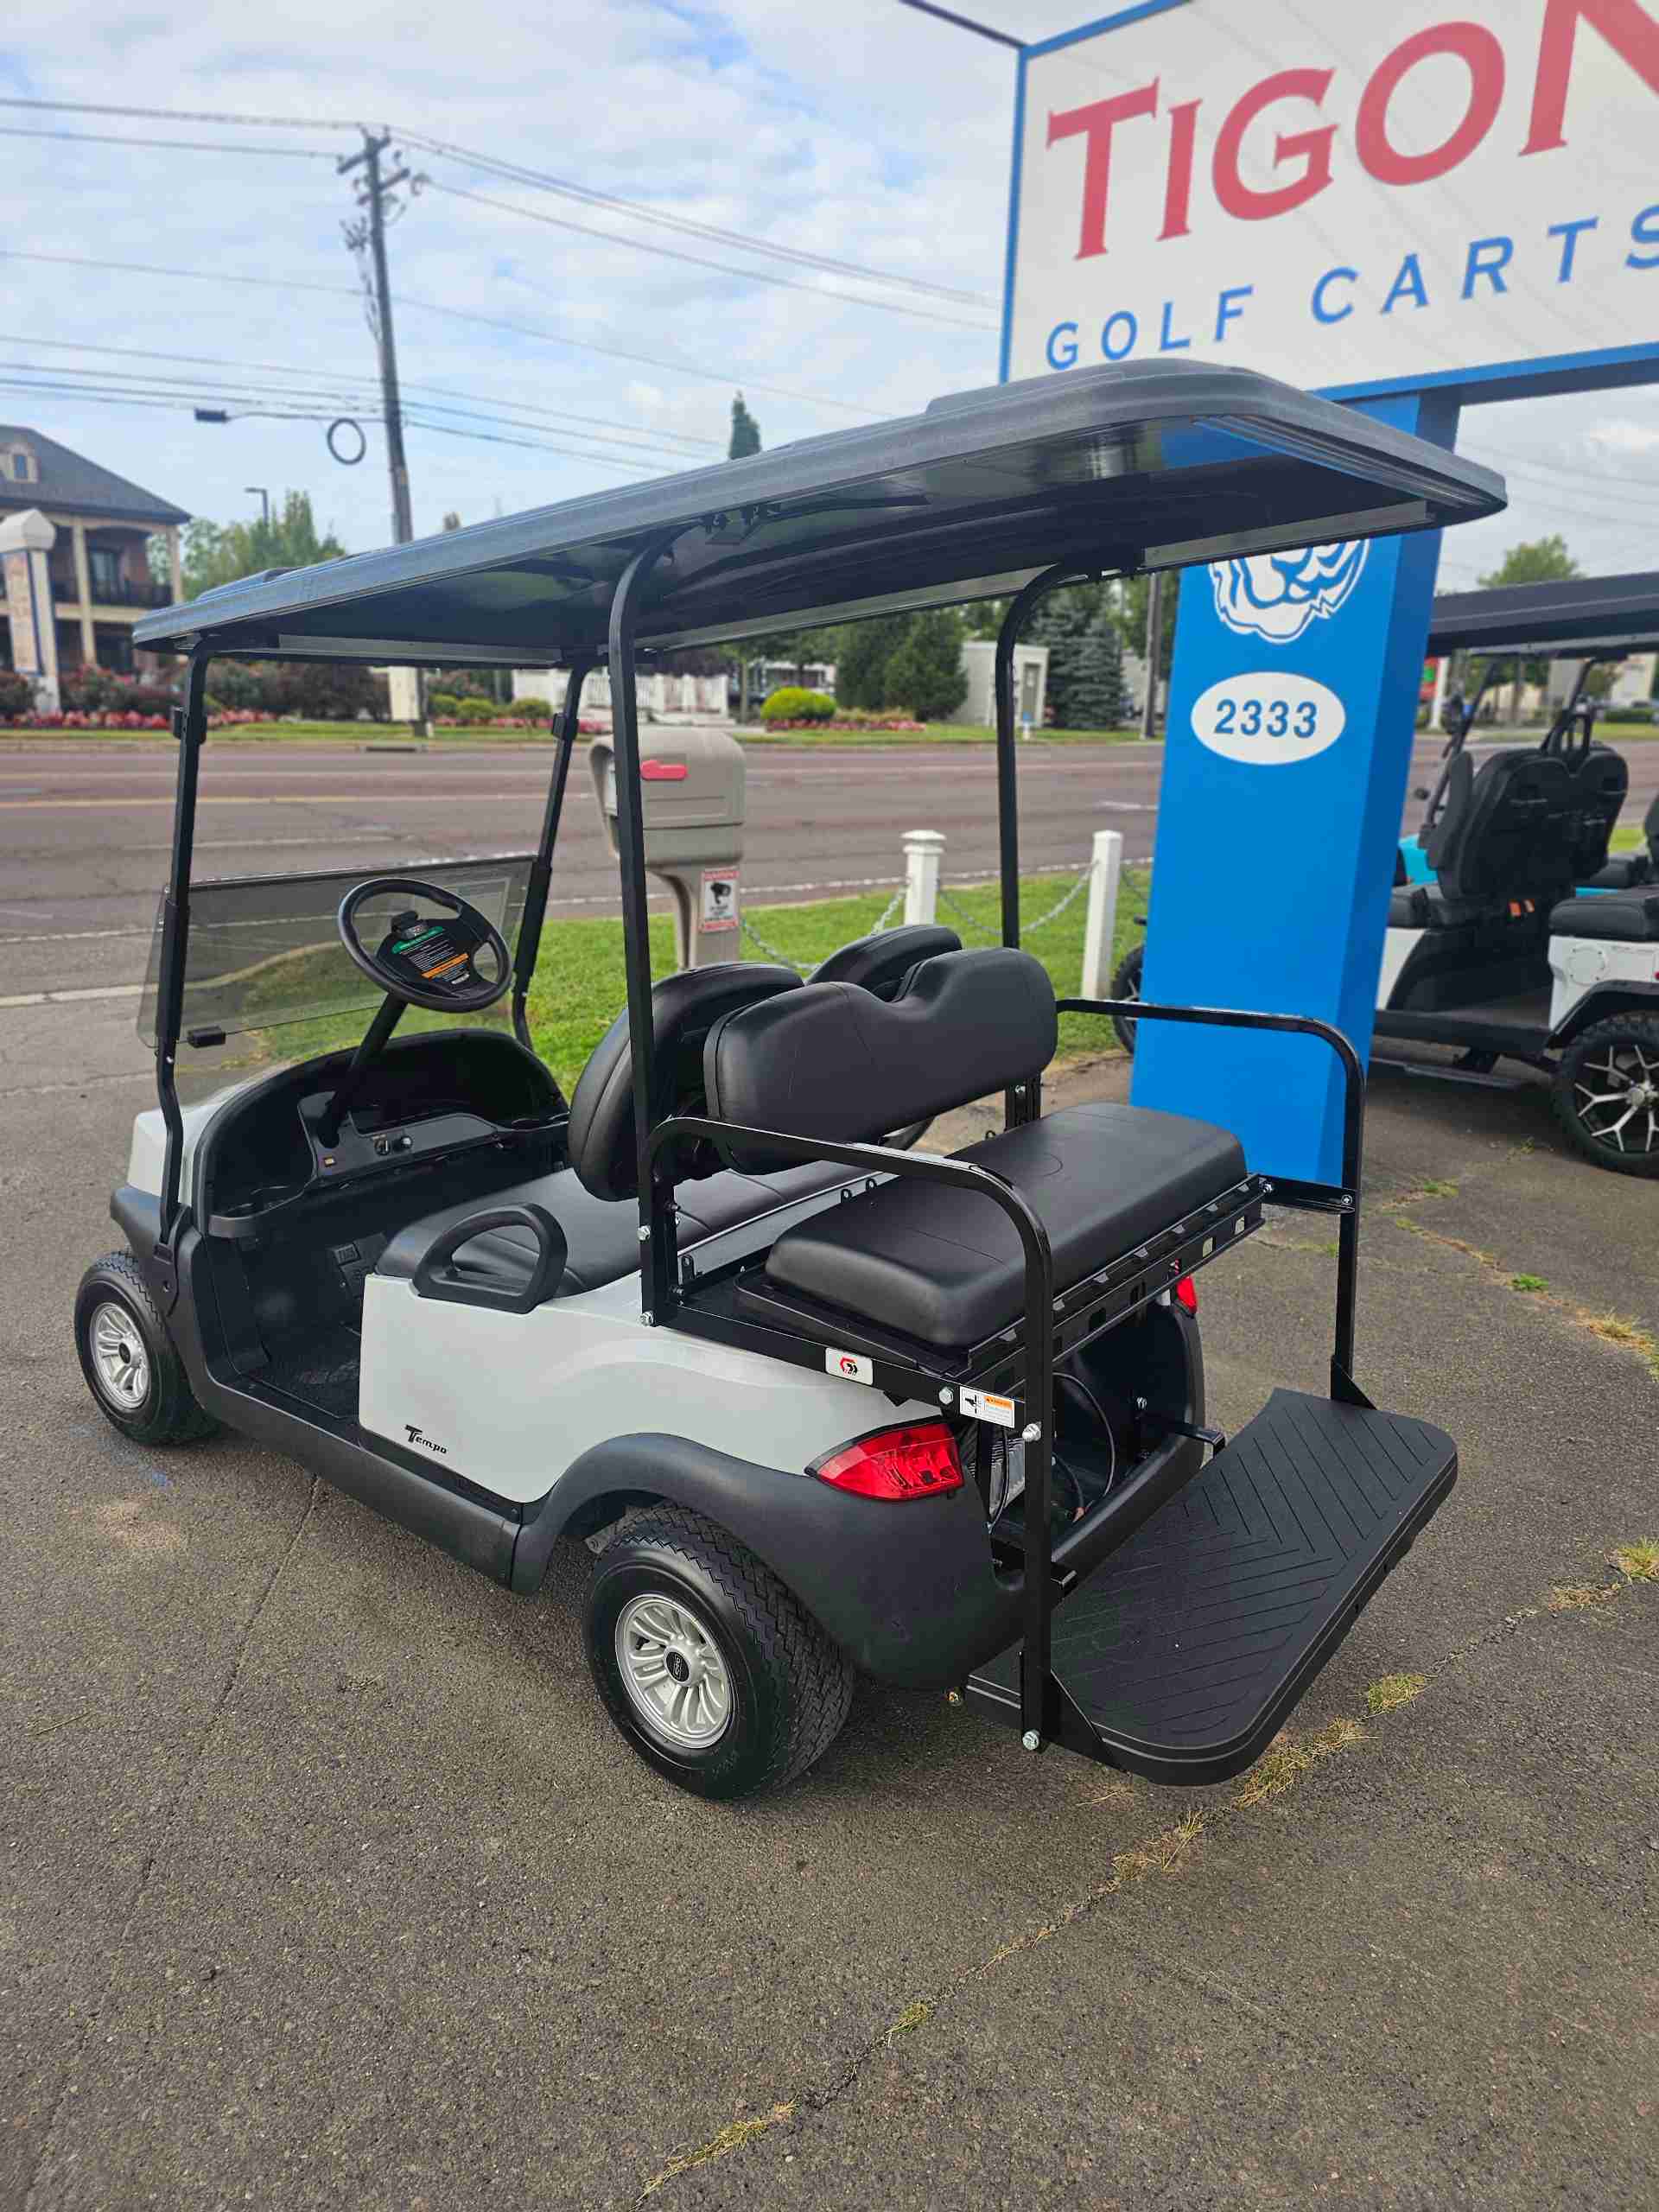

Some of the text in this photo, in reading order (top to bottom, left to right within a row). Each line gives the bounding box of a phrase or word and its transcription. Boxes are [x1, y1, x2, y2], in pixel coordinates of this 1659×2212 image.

[1046, 285, 1254, 372] GOLF
[1213, 698, 1319, 739] 2333
[404, 1424, 448, 1454] Tempo
